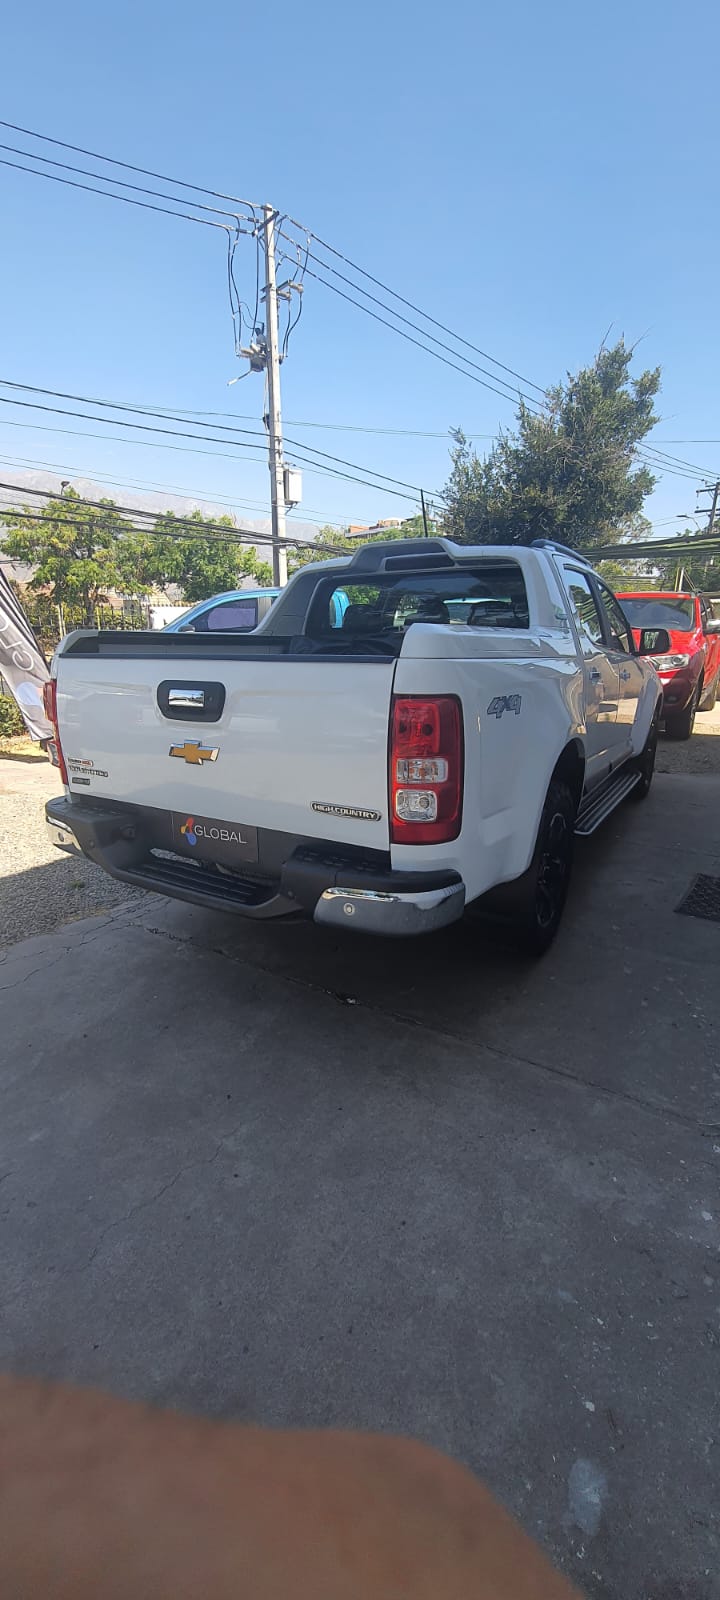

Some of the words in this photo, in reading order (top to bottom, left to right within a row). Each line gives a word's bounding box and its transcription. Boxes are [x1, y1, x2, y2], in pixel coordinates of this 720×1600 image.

[313, 803, 334, 812] HIGH
[335, 806, 376, 819] COUNTRY
[194, 825, 248, 844] GLOBAL
